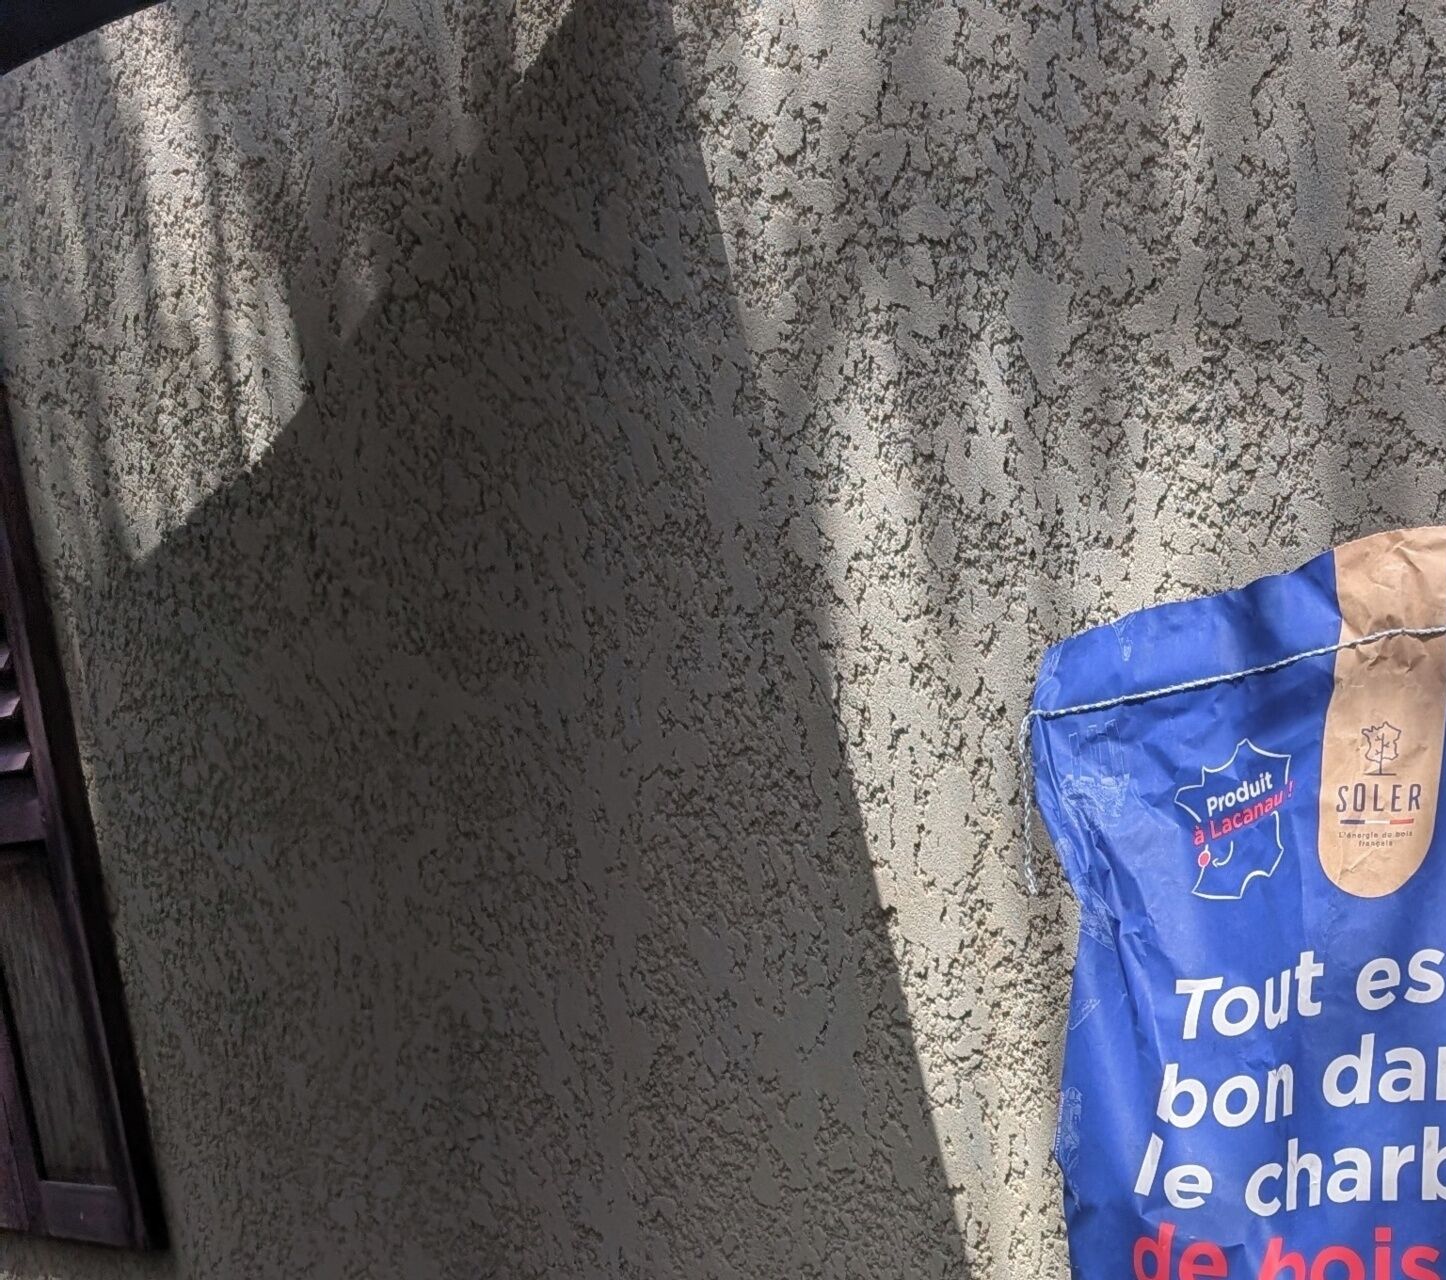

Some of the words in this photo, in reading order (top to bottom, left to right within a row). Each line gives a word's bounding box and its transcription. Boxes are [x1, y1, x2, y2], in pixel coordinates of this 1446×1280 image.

[1193, 826, 1205, 845] à
[1210, 794, 1284, 839] Lacanau
[1288, 780, 1294, 797] !
[1206, 771, 1273, 817] Produit
[1336, 783, 1421, 812] SOLER
[1175, 951, 1324, 1039] Tout
[1156, 1062, 1294, 1129] bon
[1134, 1133, 1213, 1209] le
